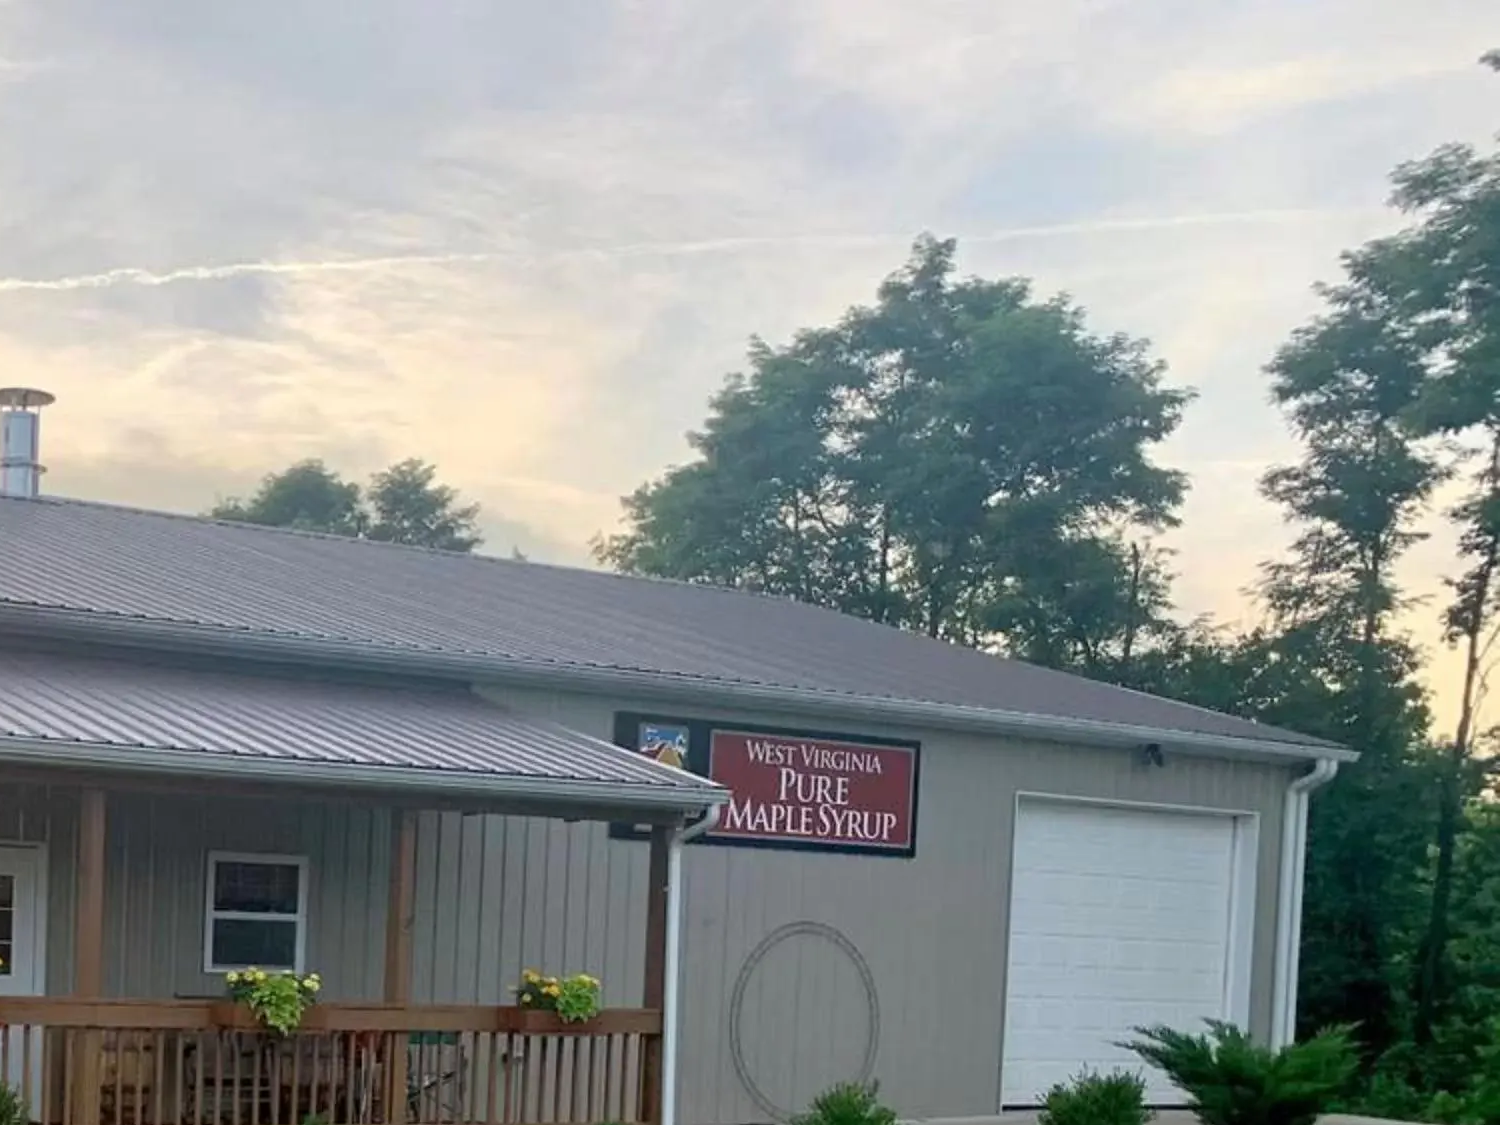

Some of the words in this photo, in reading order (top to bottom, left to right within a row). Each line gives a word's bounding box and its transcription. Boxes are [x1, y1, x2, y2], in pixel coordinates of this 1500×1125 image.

[746, 739, 797, 766] WEST
[801, 744, 881, 774] VIRGINIA
[779, 767, 849, 805] PURE
[724, 797, 813, 835] MAPLE
[816, 803, 897, 840] SYRUP
